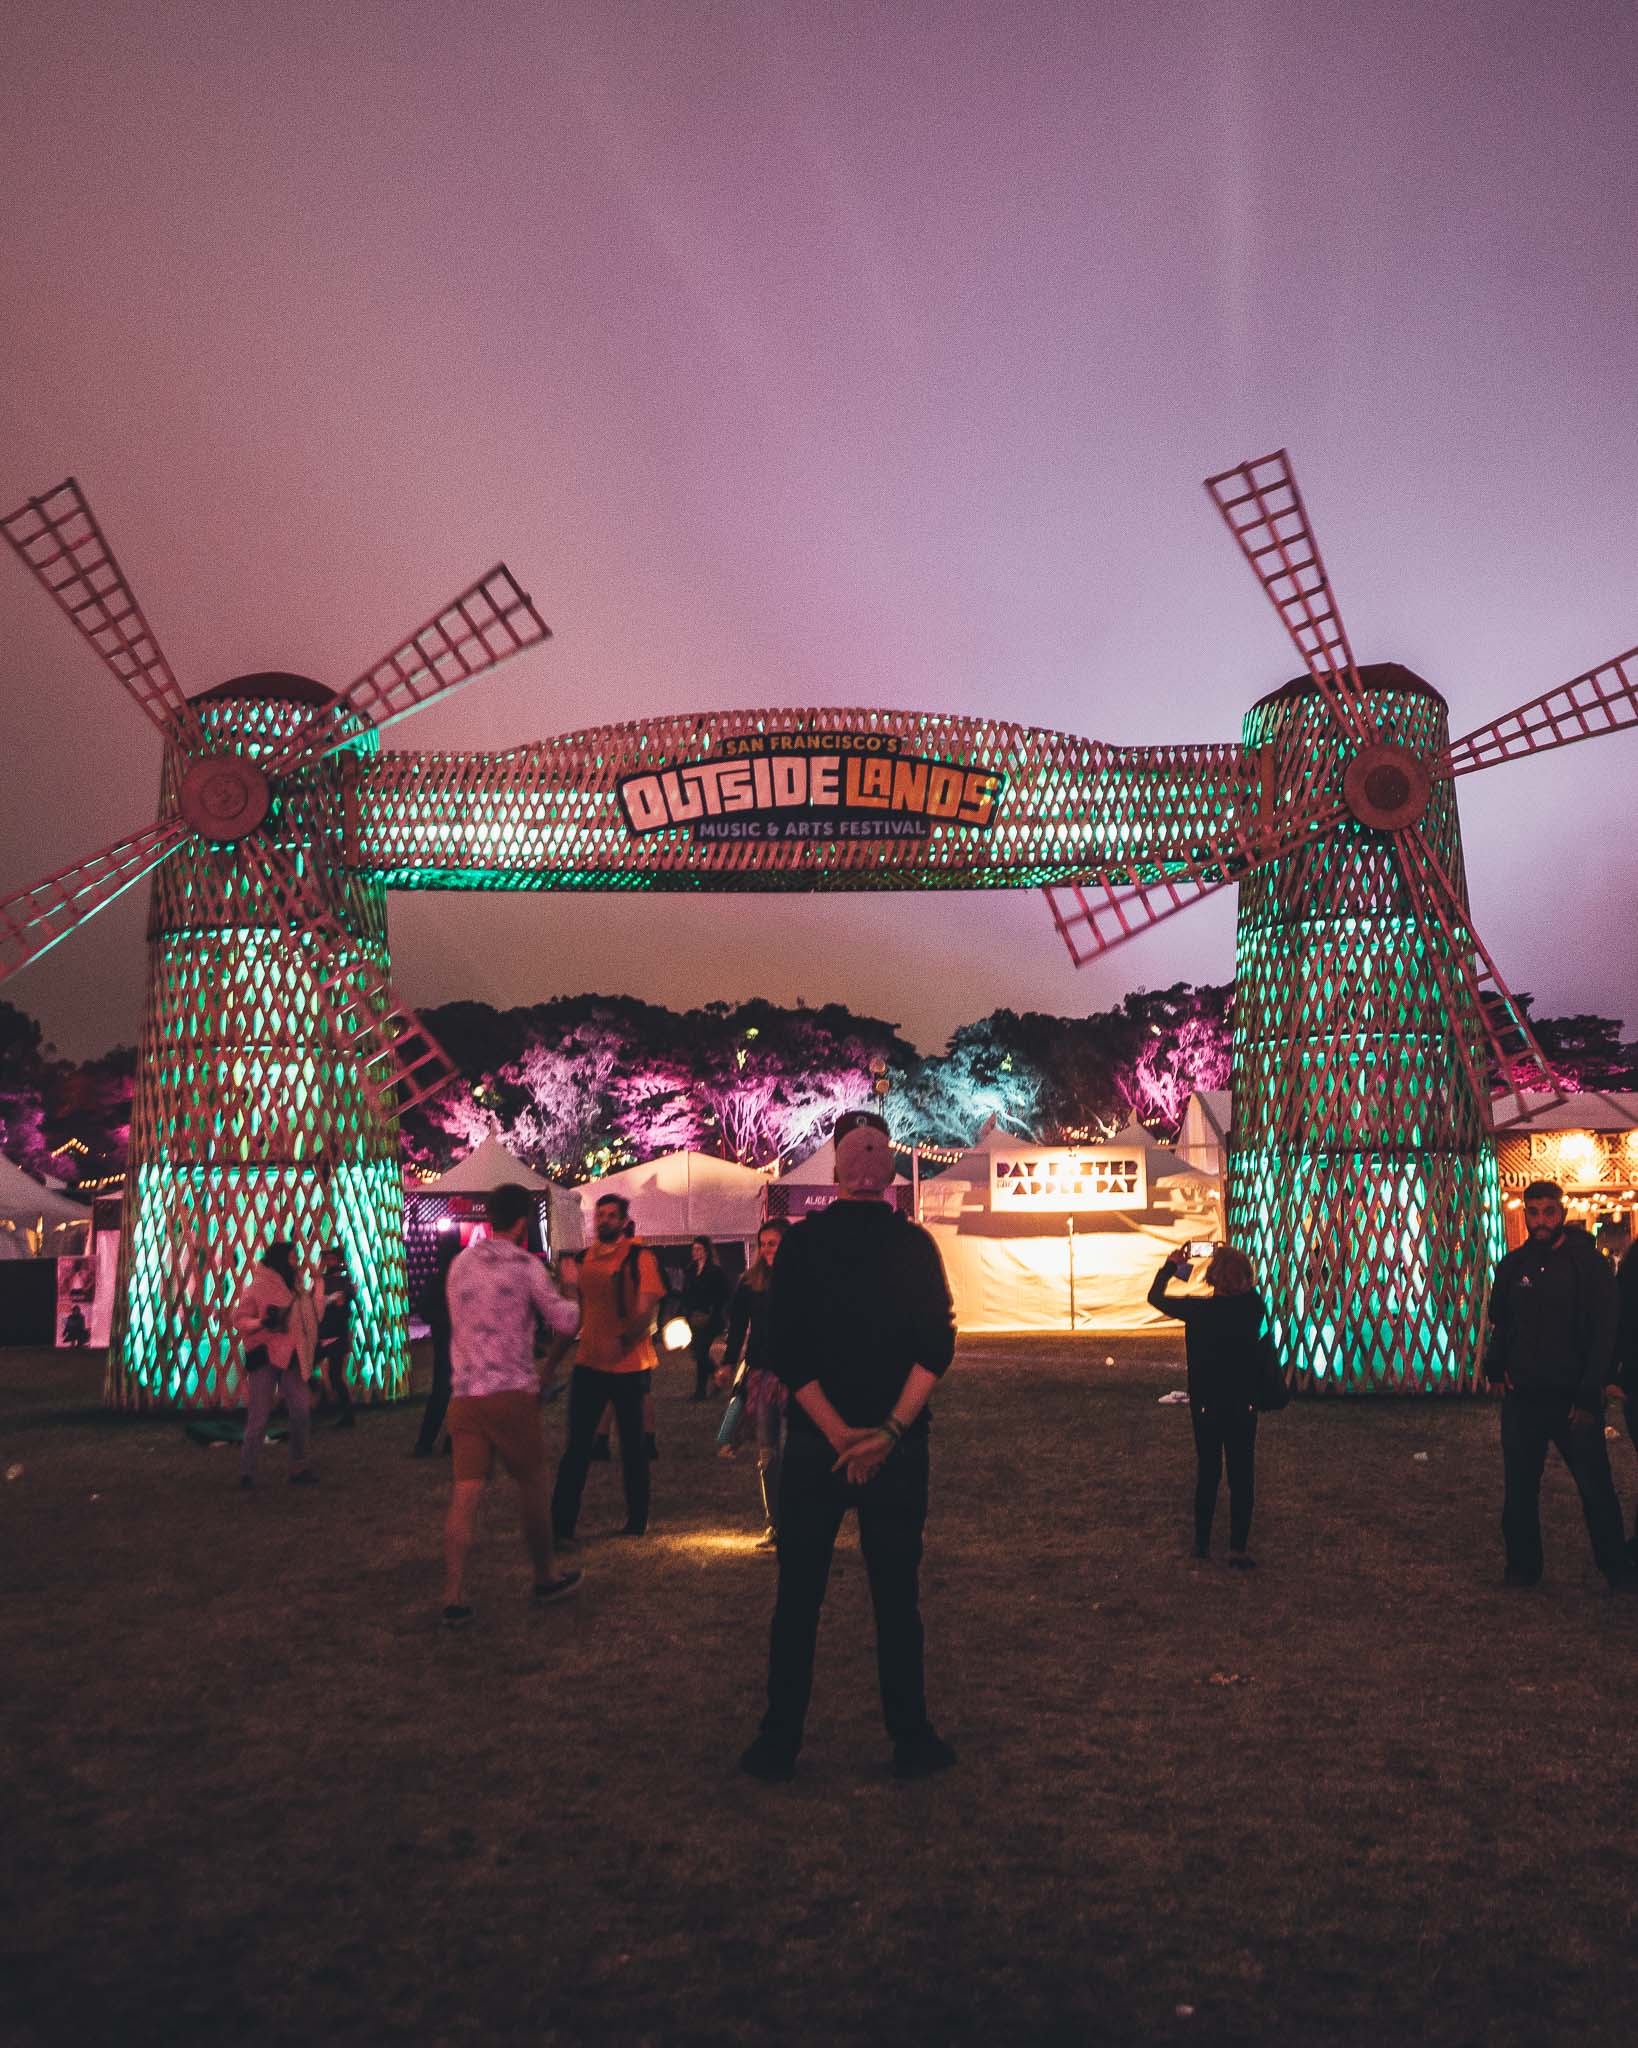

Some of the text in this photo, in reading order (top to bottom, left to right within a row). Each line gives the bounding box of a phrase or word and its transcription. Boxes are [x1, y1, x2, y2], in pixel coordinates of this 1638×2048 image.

[725, 735, 898, 756] SAN FRANCISCO'S
[621, 755, 1001, 832] OUTSIDE LANDS
[699, 820, 926, 838] MUSIC & ARTS FESTIVAL
[996, 1161, 1038, 1178] PAY
[1096, 1178, 1138, 1194] PAY
